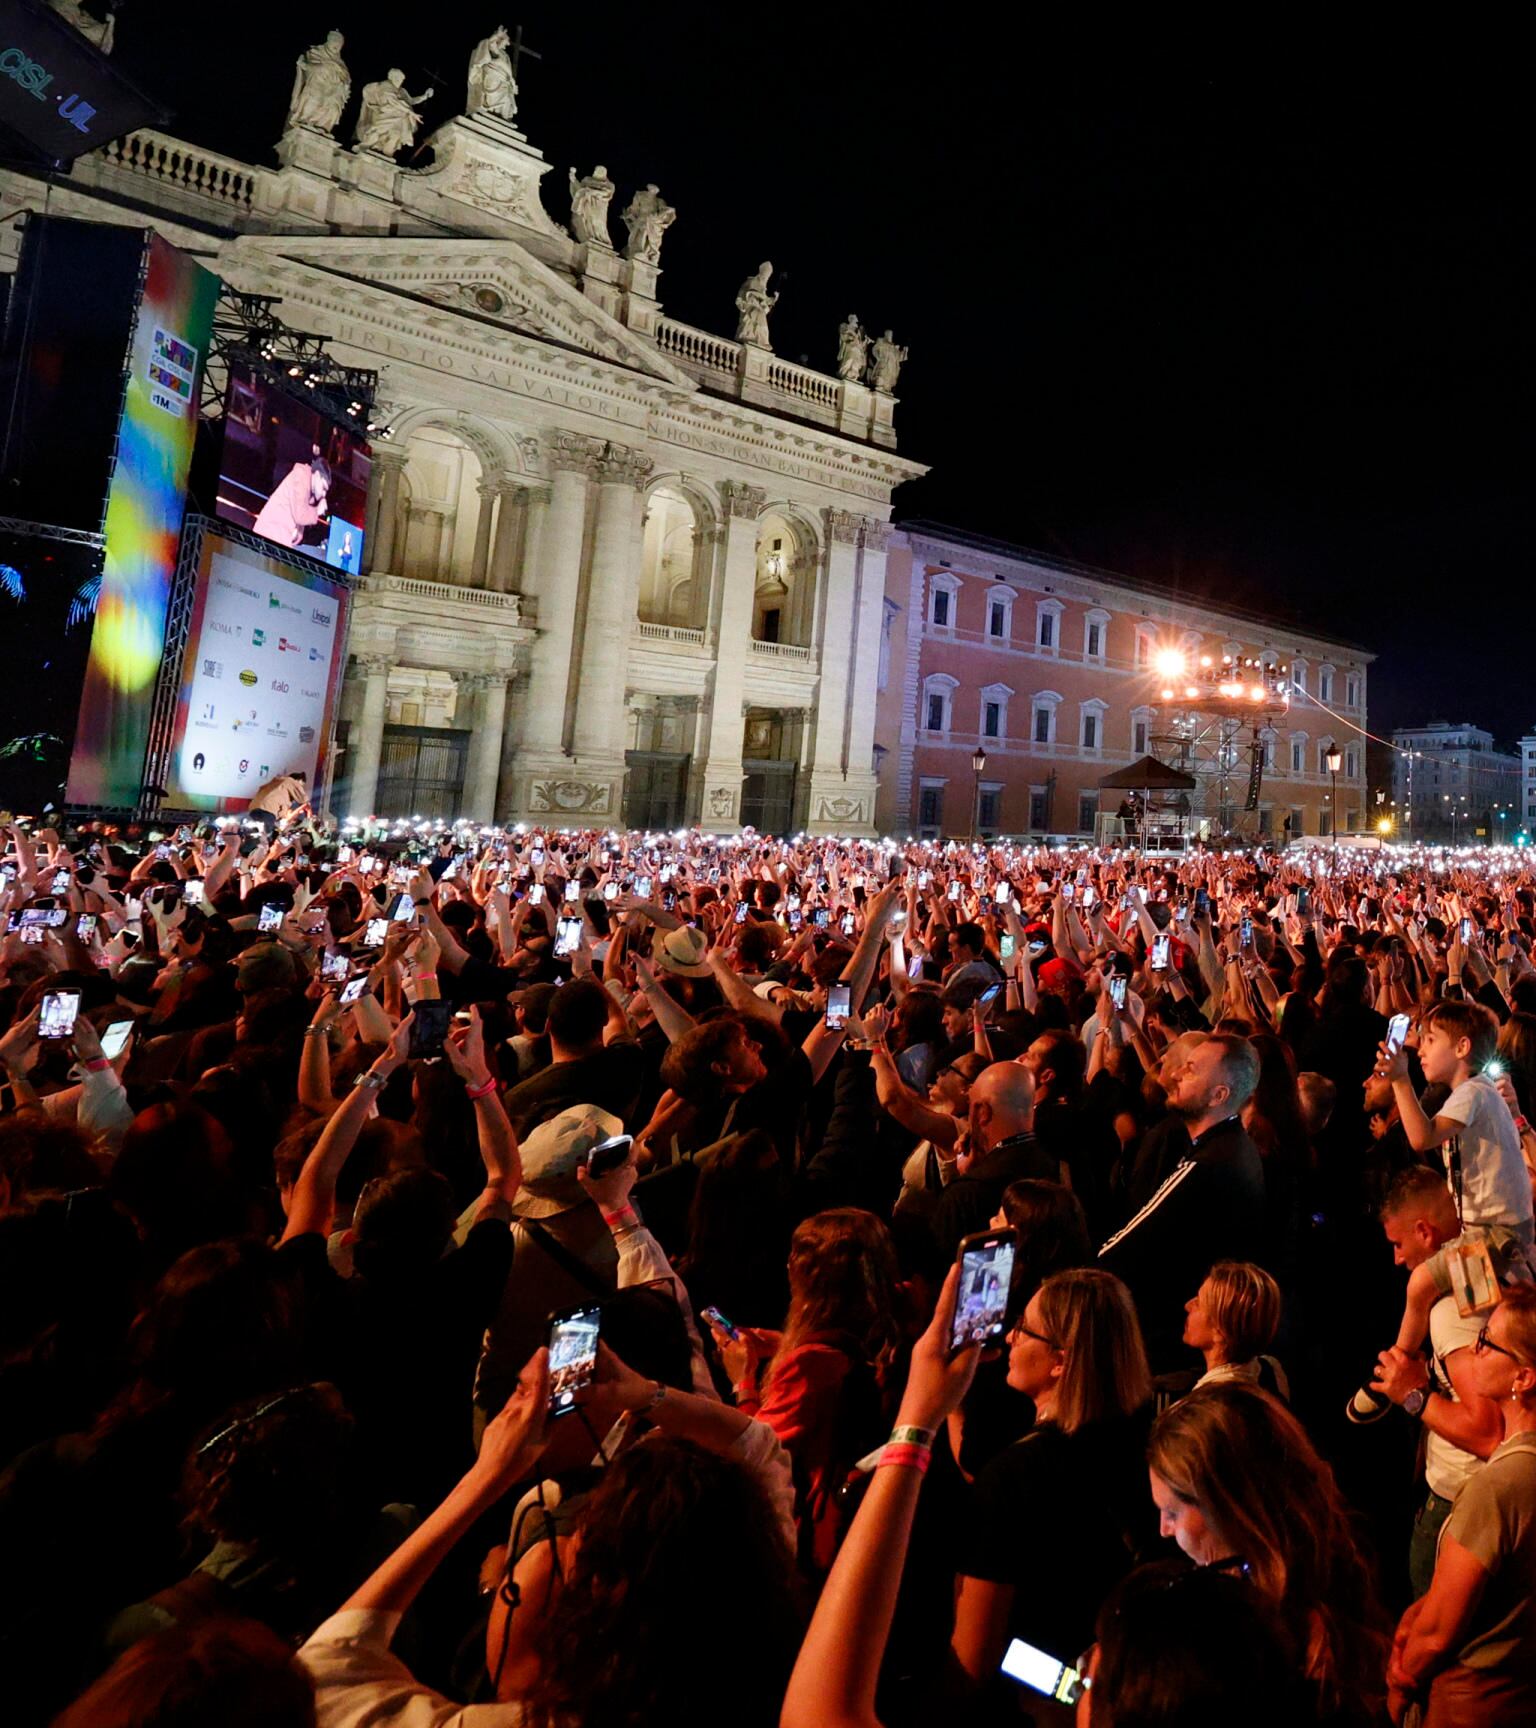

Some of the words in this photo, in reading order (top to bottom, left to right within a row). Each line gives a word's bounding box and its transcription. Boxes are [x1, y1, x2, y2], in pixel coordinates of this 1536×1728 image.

[0, 47, 54, 101] CISL
[311, 316, 454, 369] CHRISTO
[470, 363, 622, 419] SALVATORI
